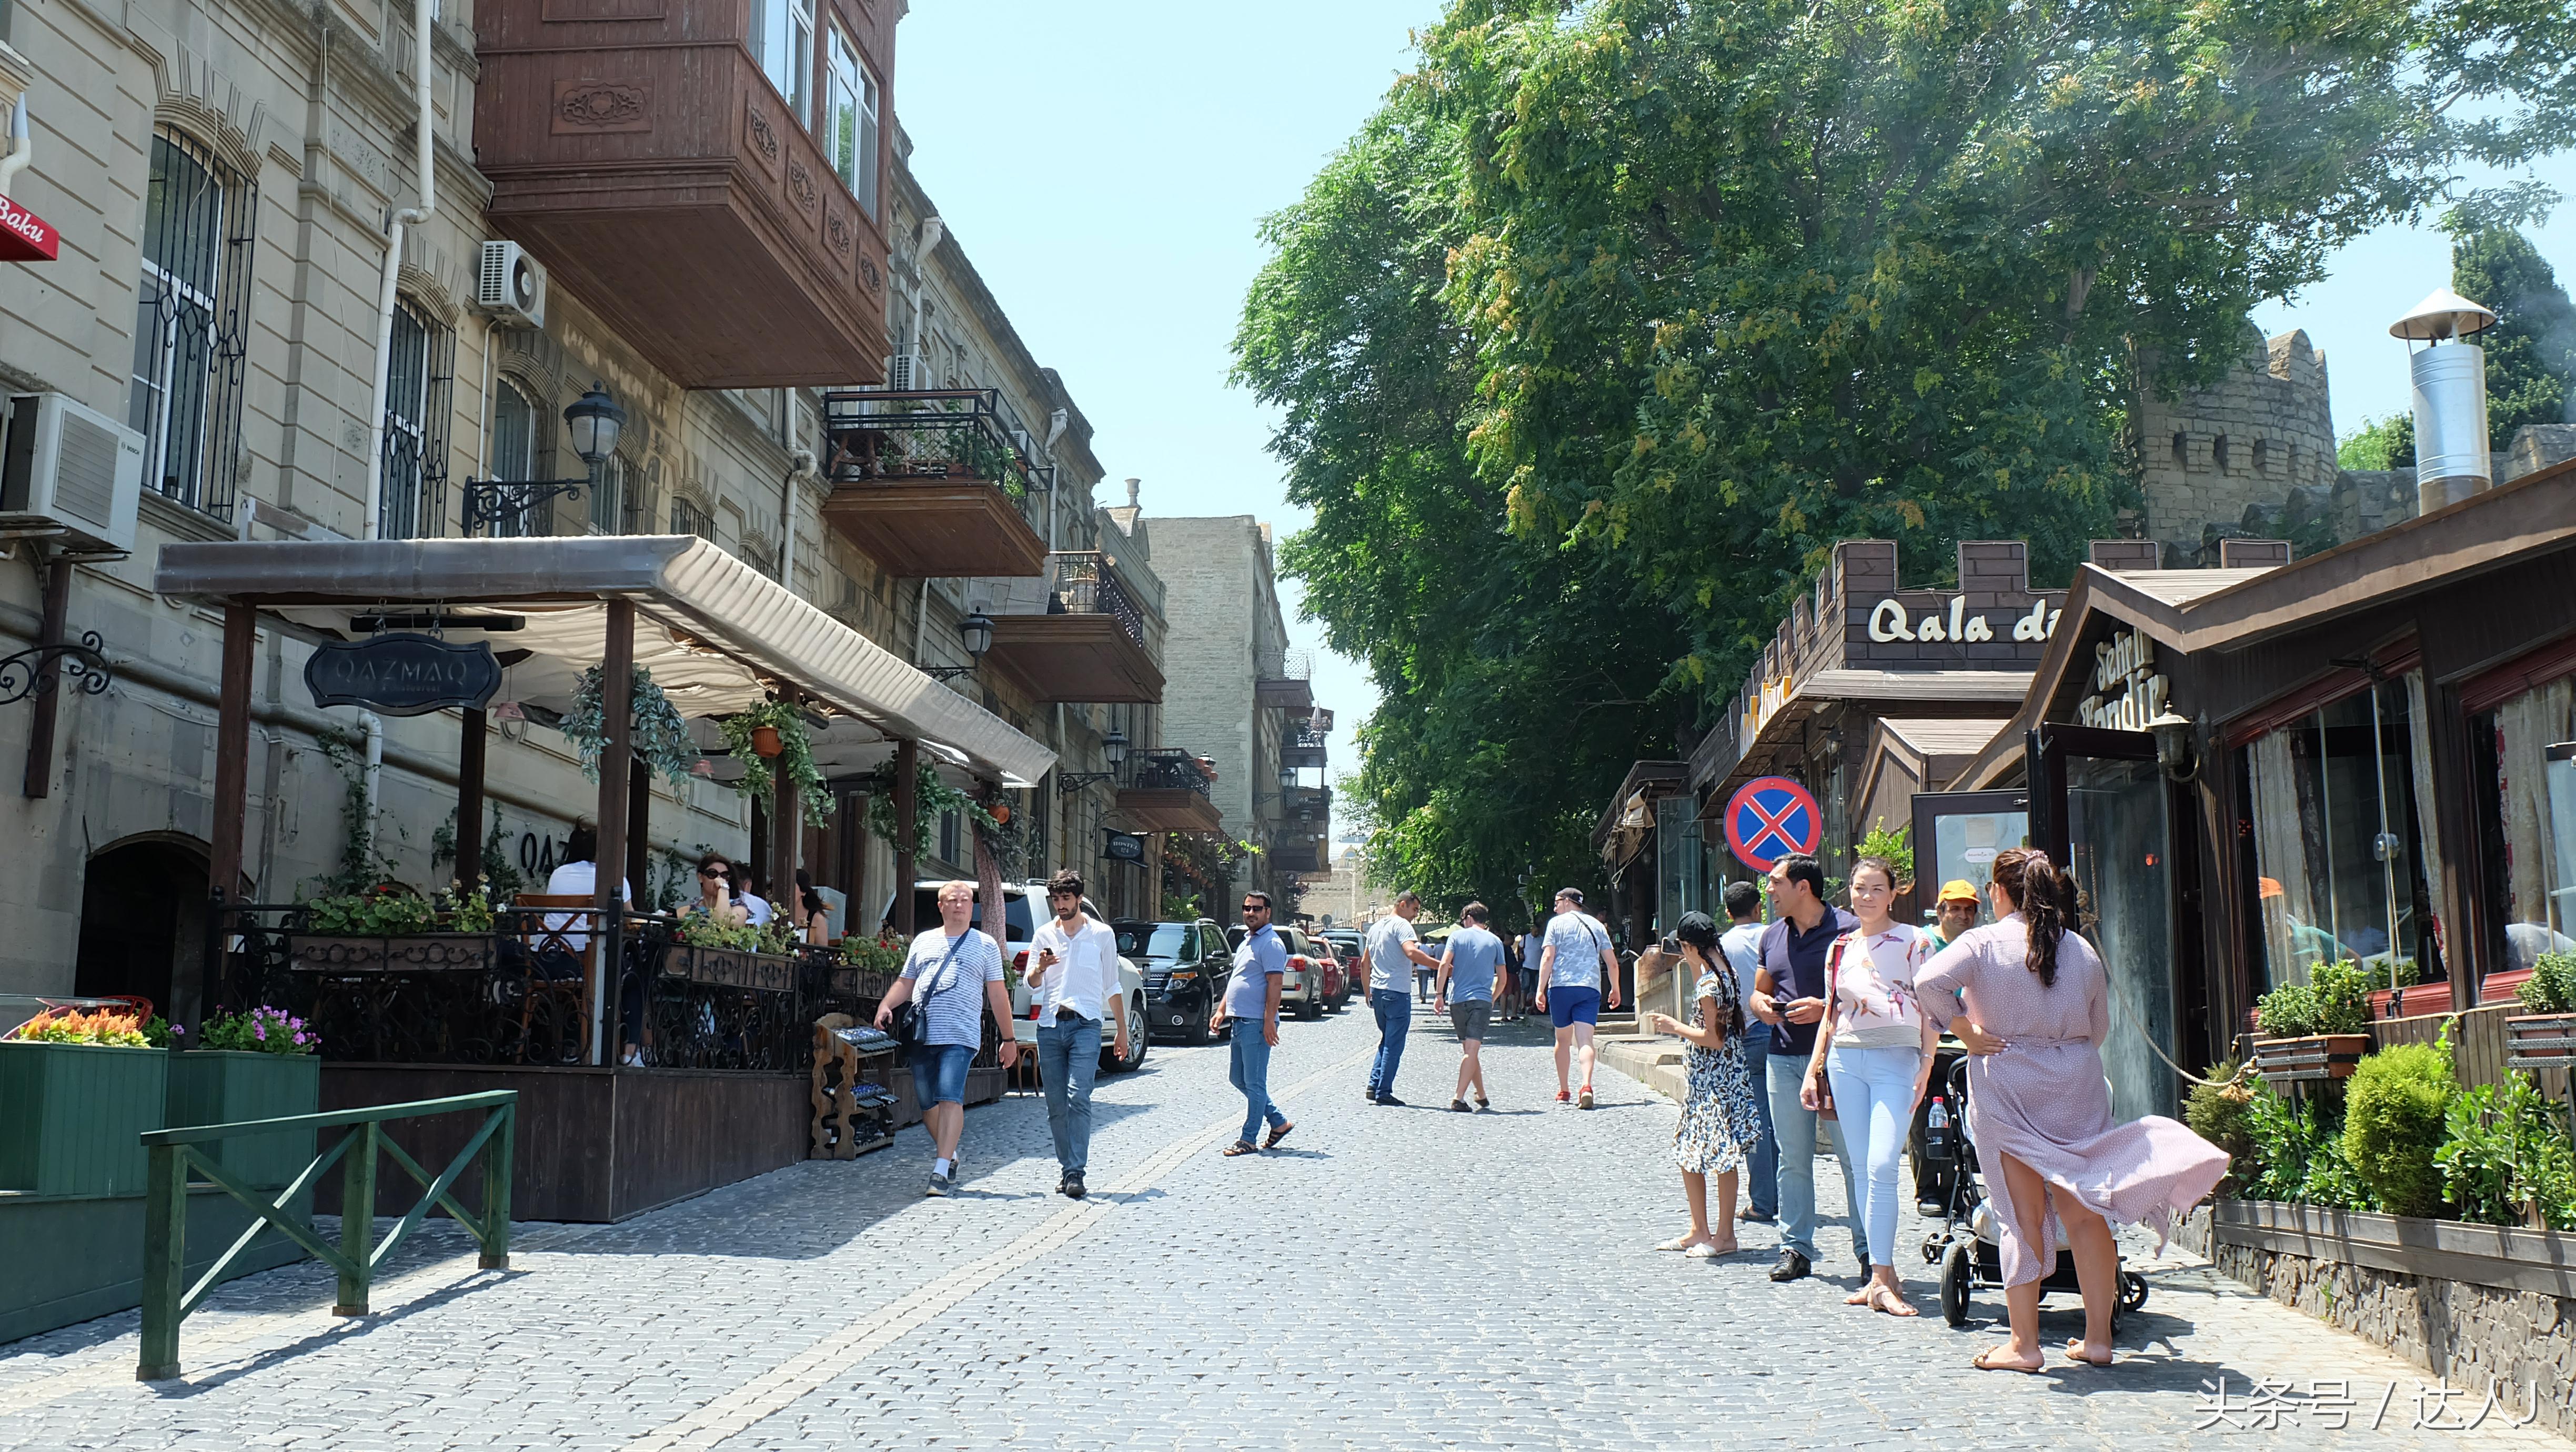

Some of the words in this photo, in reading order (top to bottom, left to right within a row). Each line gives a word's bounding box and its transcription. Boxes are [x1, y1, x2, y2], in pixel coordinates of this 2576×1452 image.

[1868, 595, 1993, 642] Qala
[336, 657, 467, 686] QAZMAQ
[1113, 841, 1139, 851] HOSTEL
